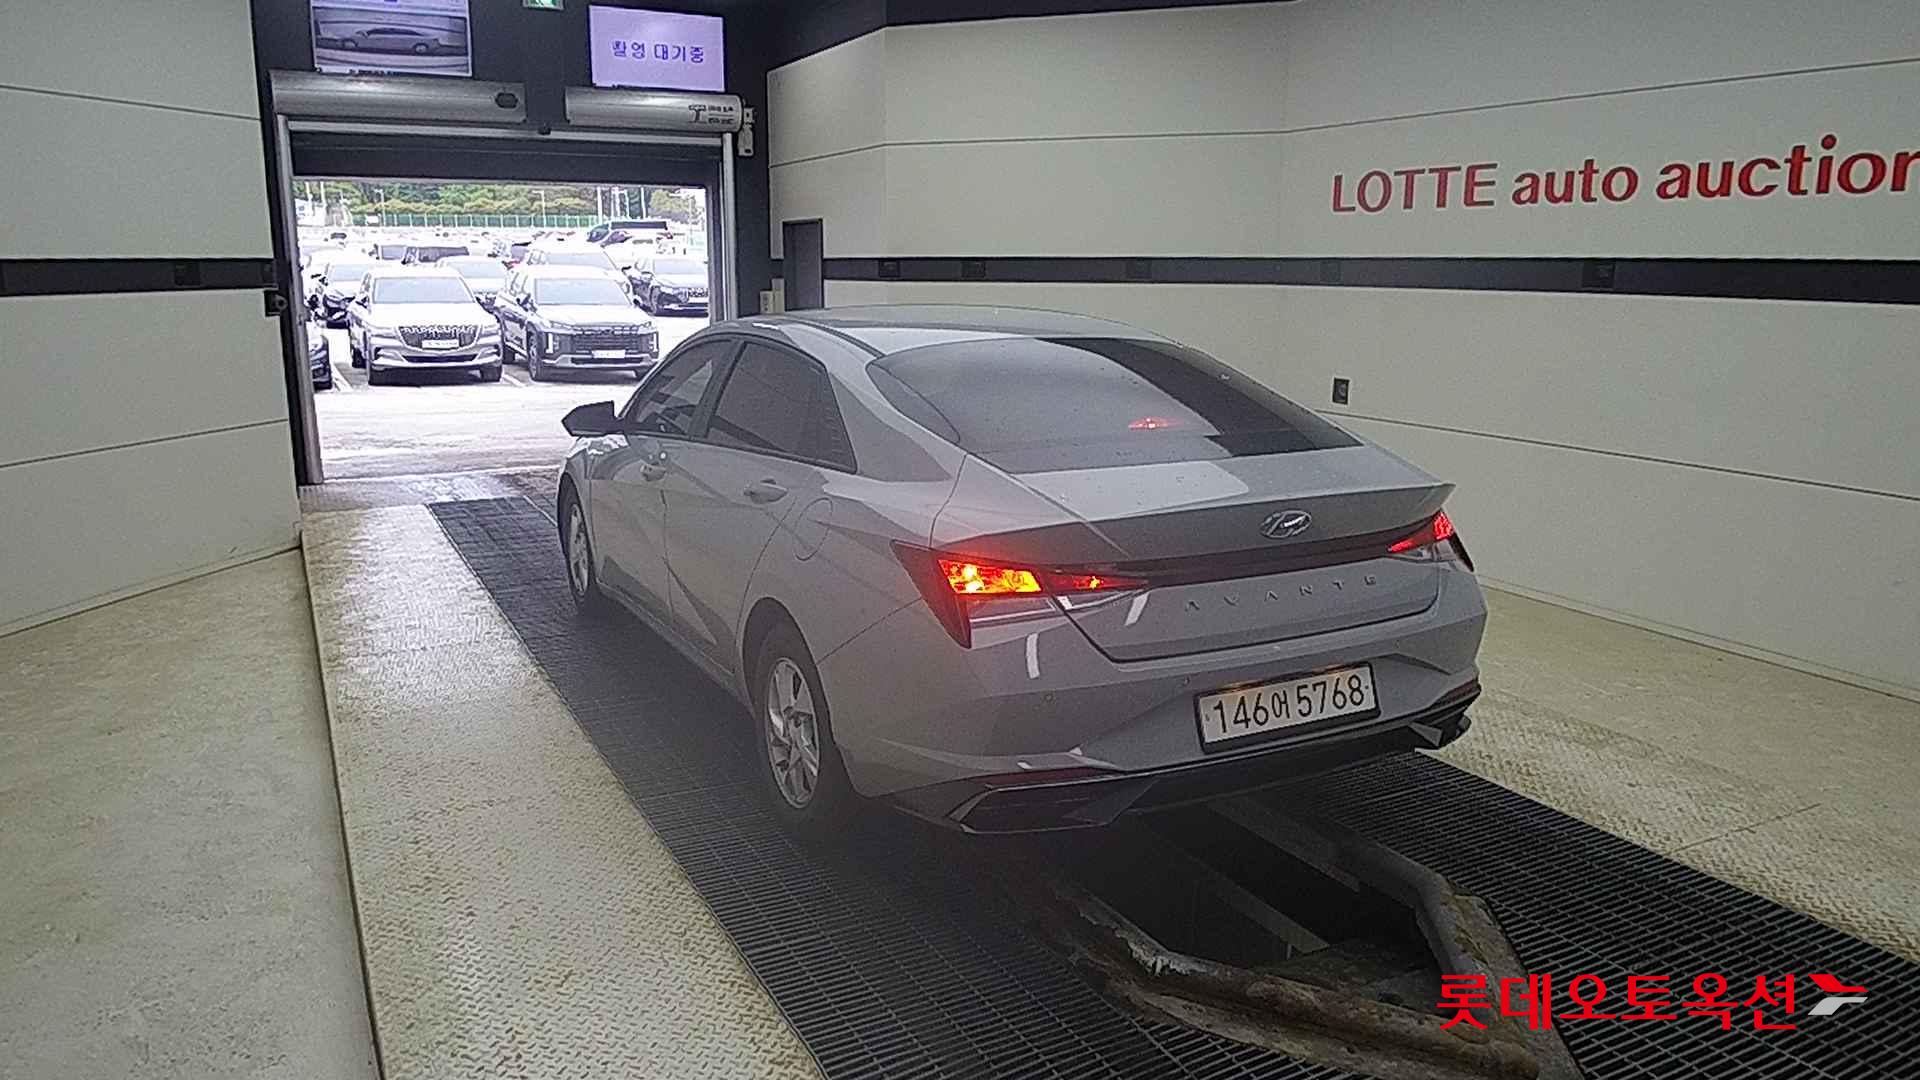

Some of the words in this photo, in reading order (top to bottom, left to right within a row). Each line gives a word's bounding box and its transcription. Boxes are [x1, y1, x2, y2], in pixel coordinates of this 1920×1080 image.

[654, 44, 704, 64] 대기중
[1331, 162, 1498, 213] LOTTE
[1511, 158, 1639, 206] auto
[1185, 574, 1377, 613] AVANTE
